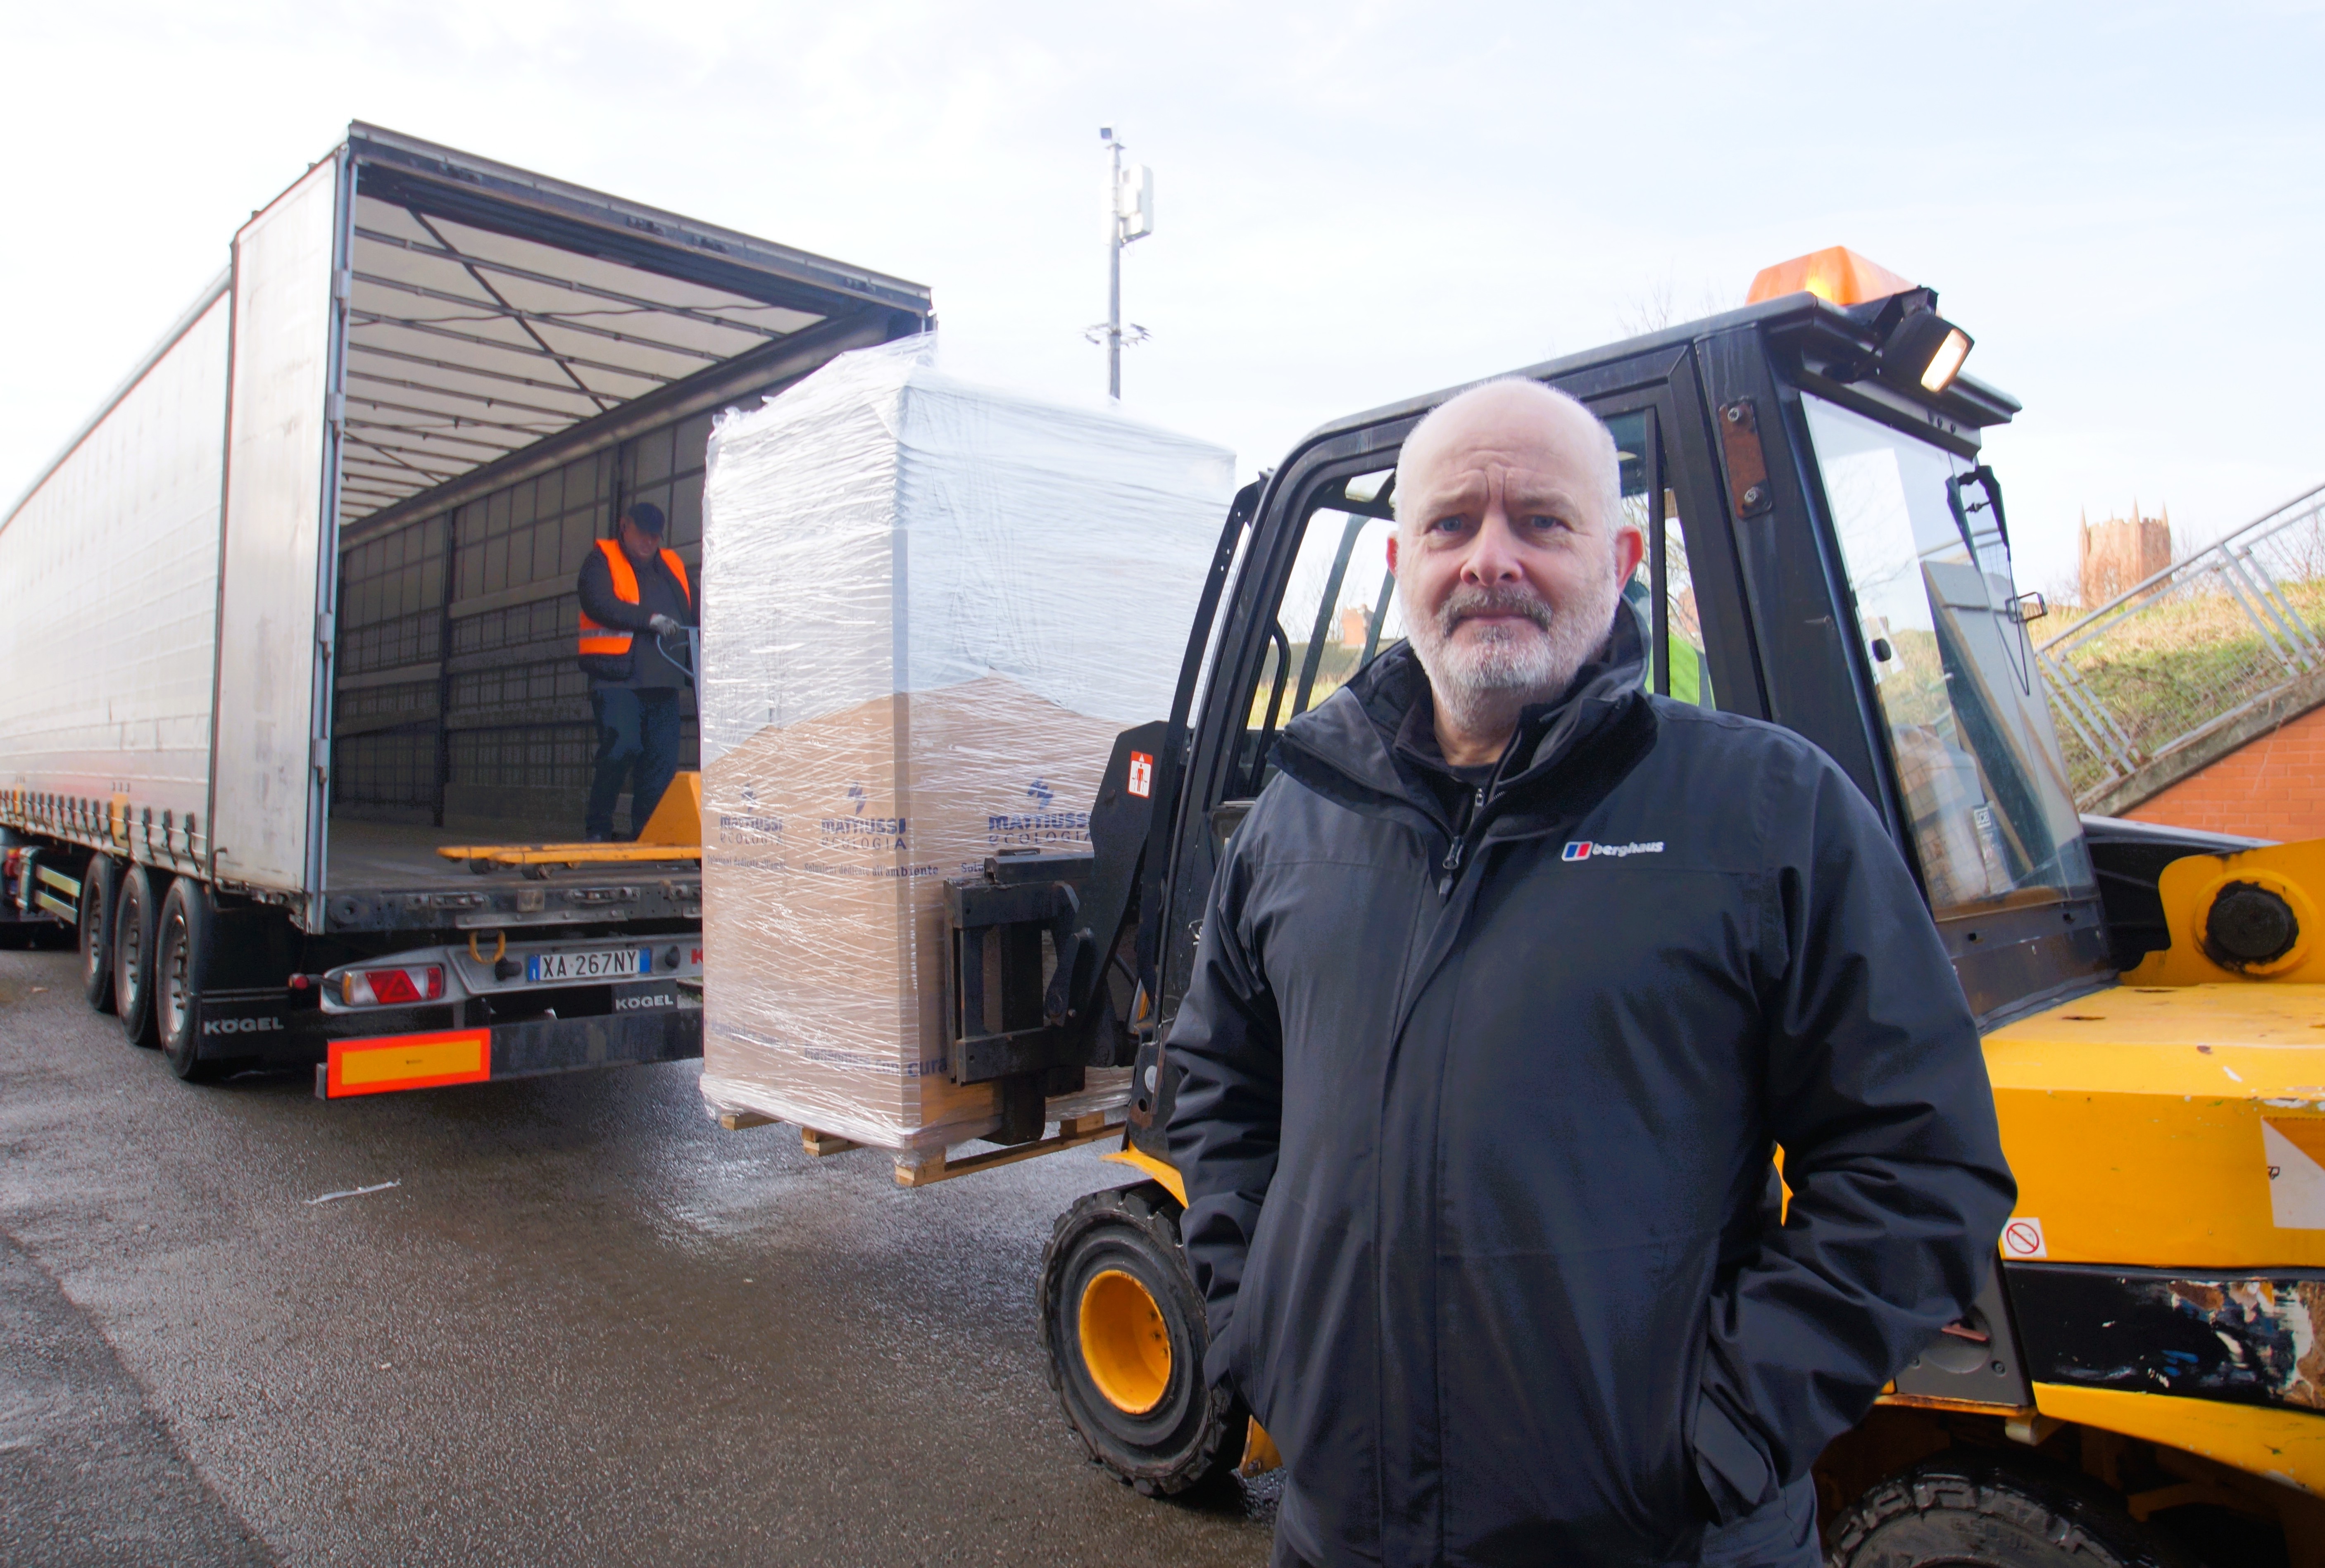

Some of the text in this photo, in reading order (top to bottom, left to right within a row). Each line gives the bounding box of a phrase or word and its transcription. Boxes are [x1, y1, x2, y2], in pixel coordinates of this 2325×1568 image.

[1592, 841, 1664, 858] berghaus
[543, 955, 568, 978] XA
[576, 950, 637, 975] 267NY
[908, 1057, 947, 1077] cura
